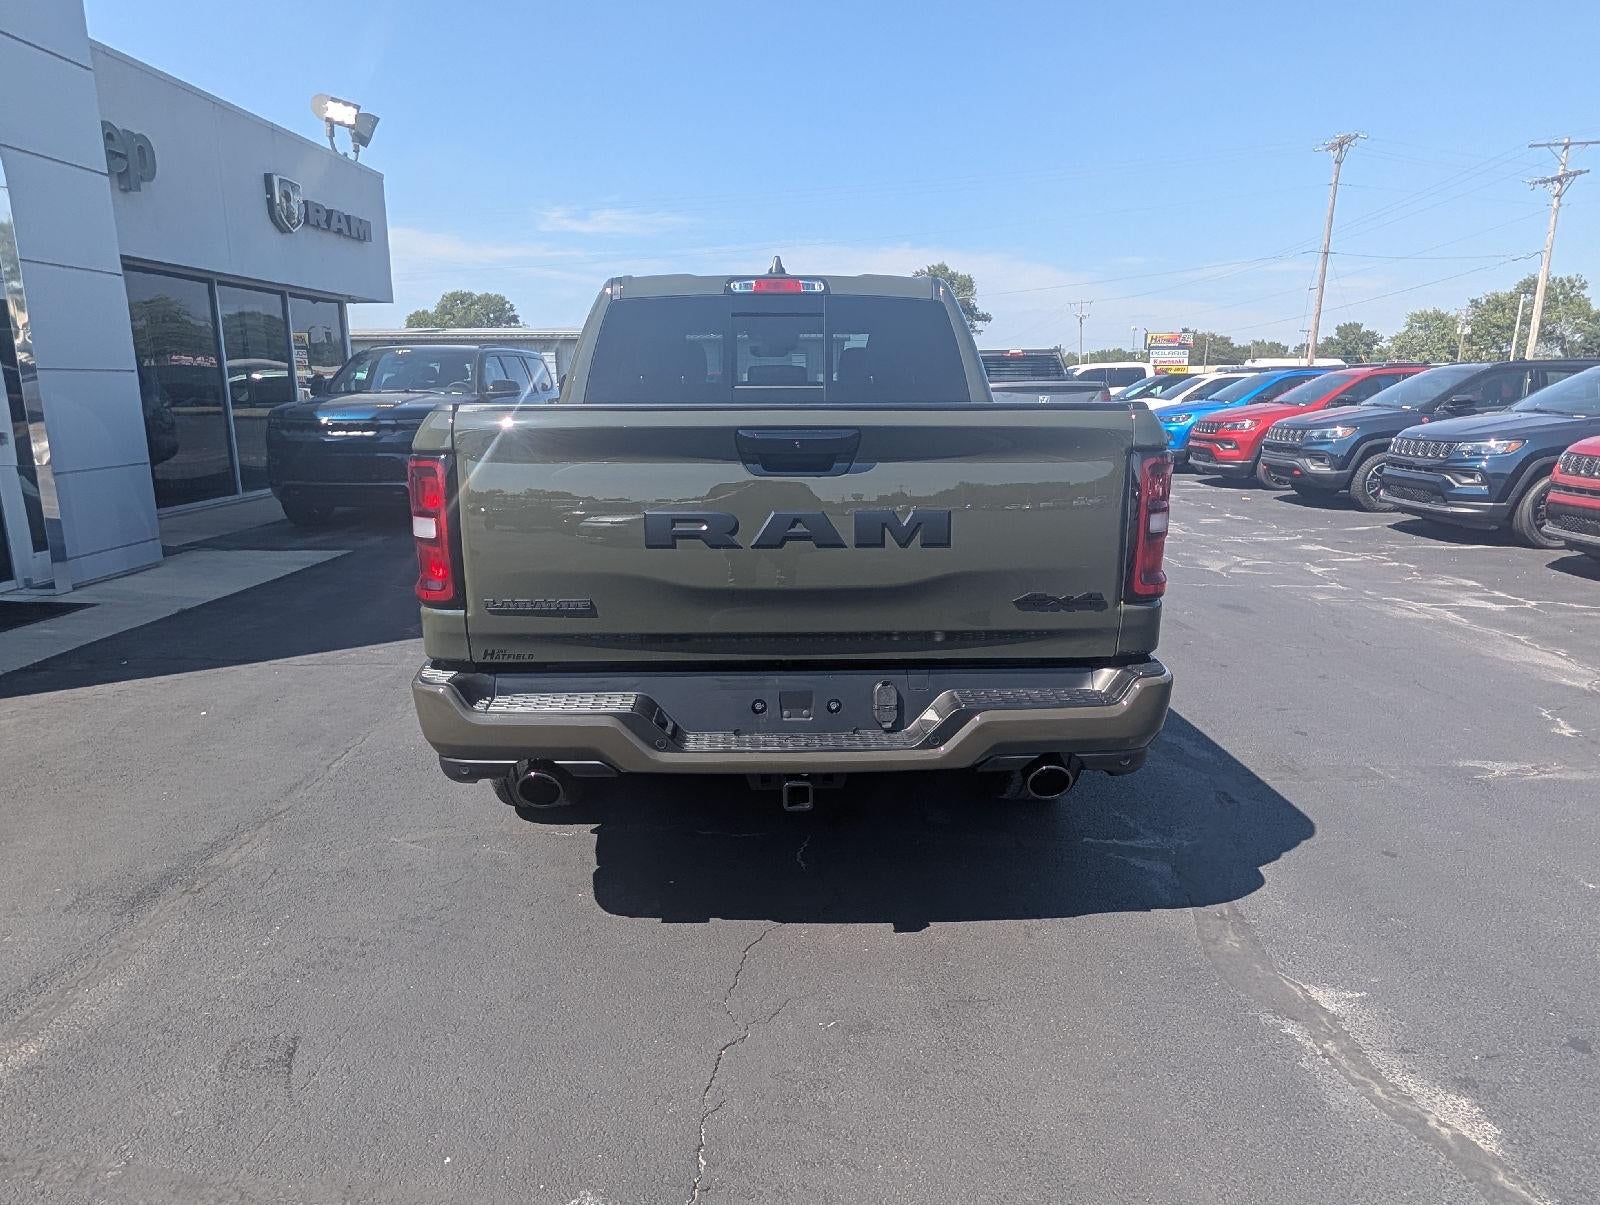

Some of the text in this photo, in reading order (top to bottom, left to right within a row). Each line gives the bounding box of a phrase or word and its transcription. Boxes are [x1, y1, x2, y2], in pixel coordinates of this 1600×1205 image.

[303, 199, 372, 242] RAM
[643, 509, 952, 549] RAM
[484, 598, 595, 614] LARAMIE
[483, 648, 534, 660] HATFIELD
